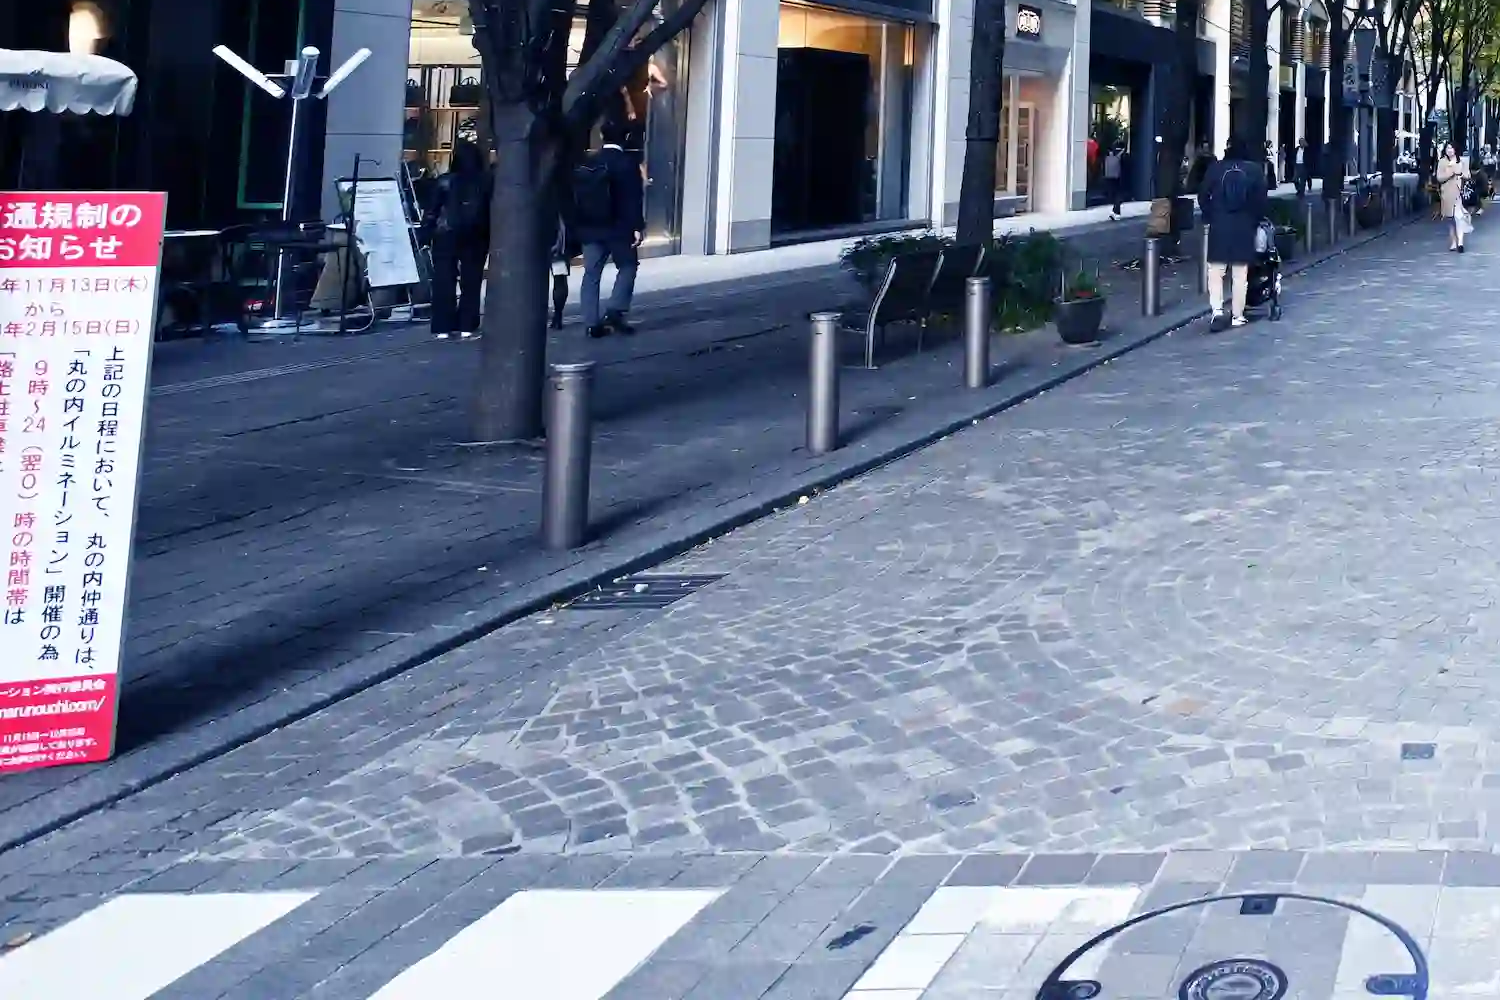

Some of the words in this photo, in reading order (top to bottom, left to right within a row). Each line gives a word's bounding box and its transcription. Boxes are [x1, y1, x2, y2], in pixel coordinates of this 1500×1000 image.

[0, 202, 142, 229] 通規制の
[24, 301, 64, 317] から
[0, 319, 140, 338] 年2月15日(日)
